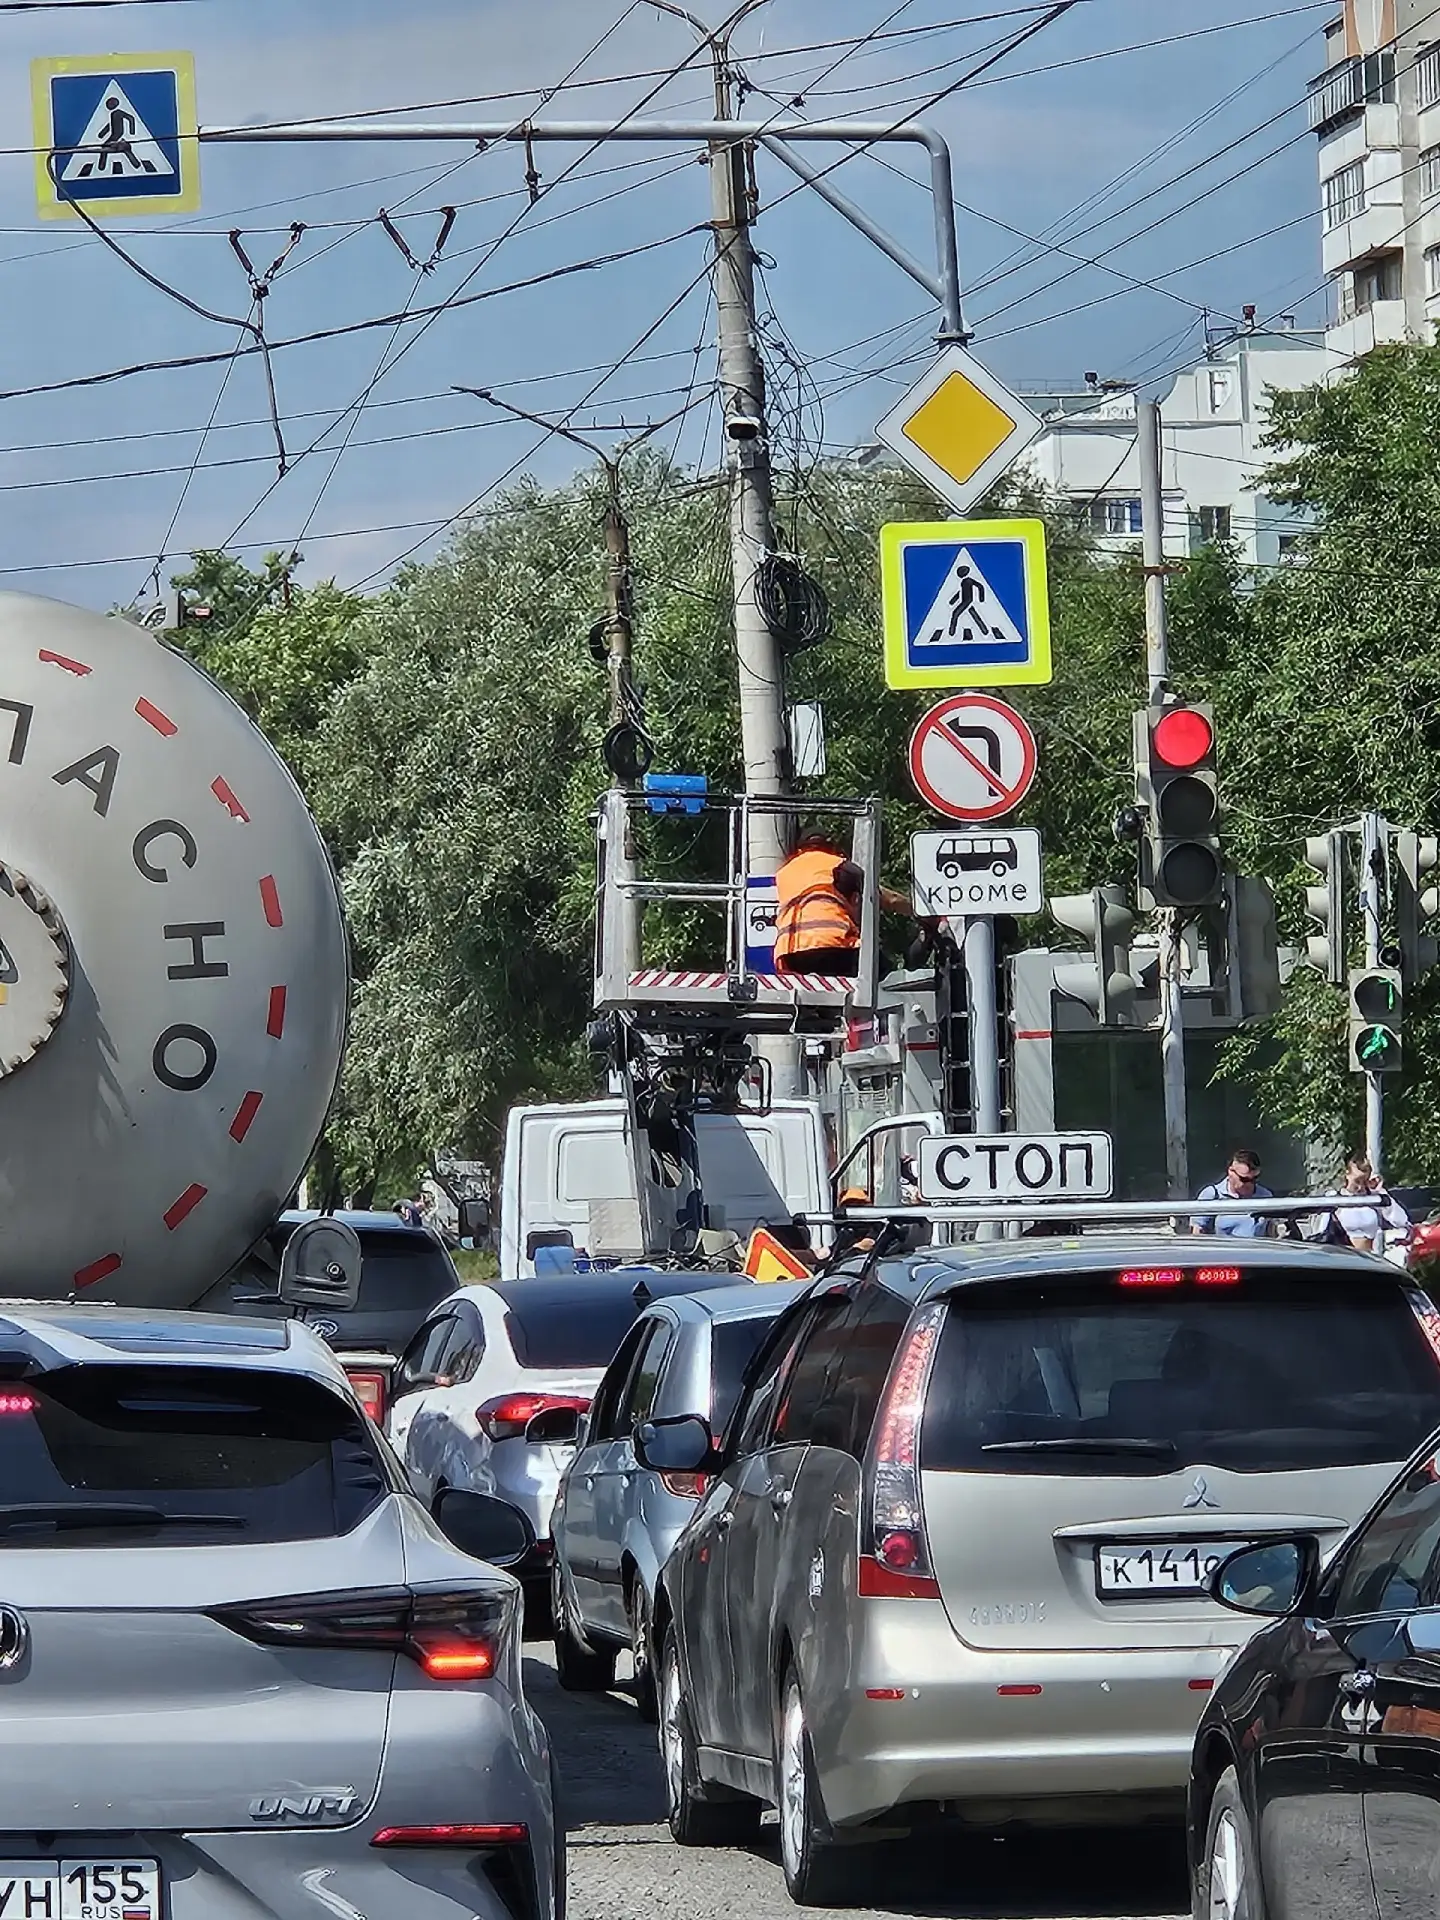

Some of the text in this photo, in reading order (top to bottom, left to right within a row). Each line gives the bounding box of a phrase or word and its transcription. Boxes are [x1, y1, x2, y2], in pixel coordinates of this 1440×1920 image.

[928, 884, 1027, 909] кроме
[936, 1143, 1093, 1191] СТОП
[249, 1796, 358, 1818] UNI-T
[66, 1865, 143, 1903] 155
[81, 1906, 120, 1919] RUS
